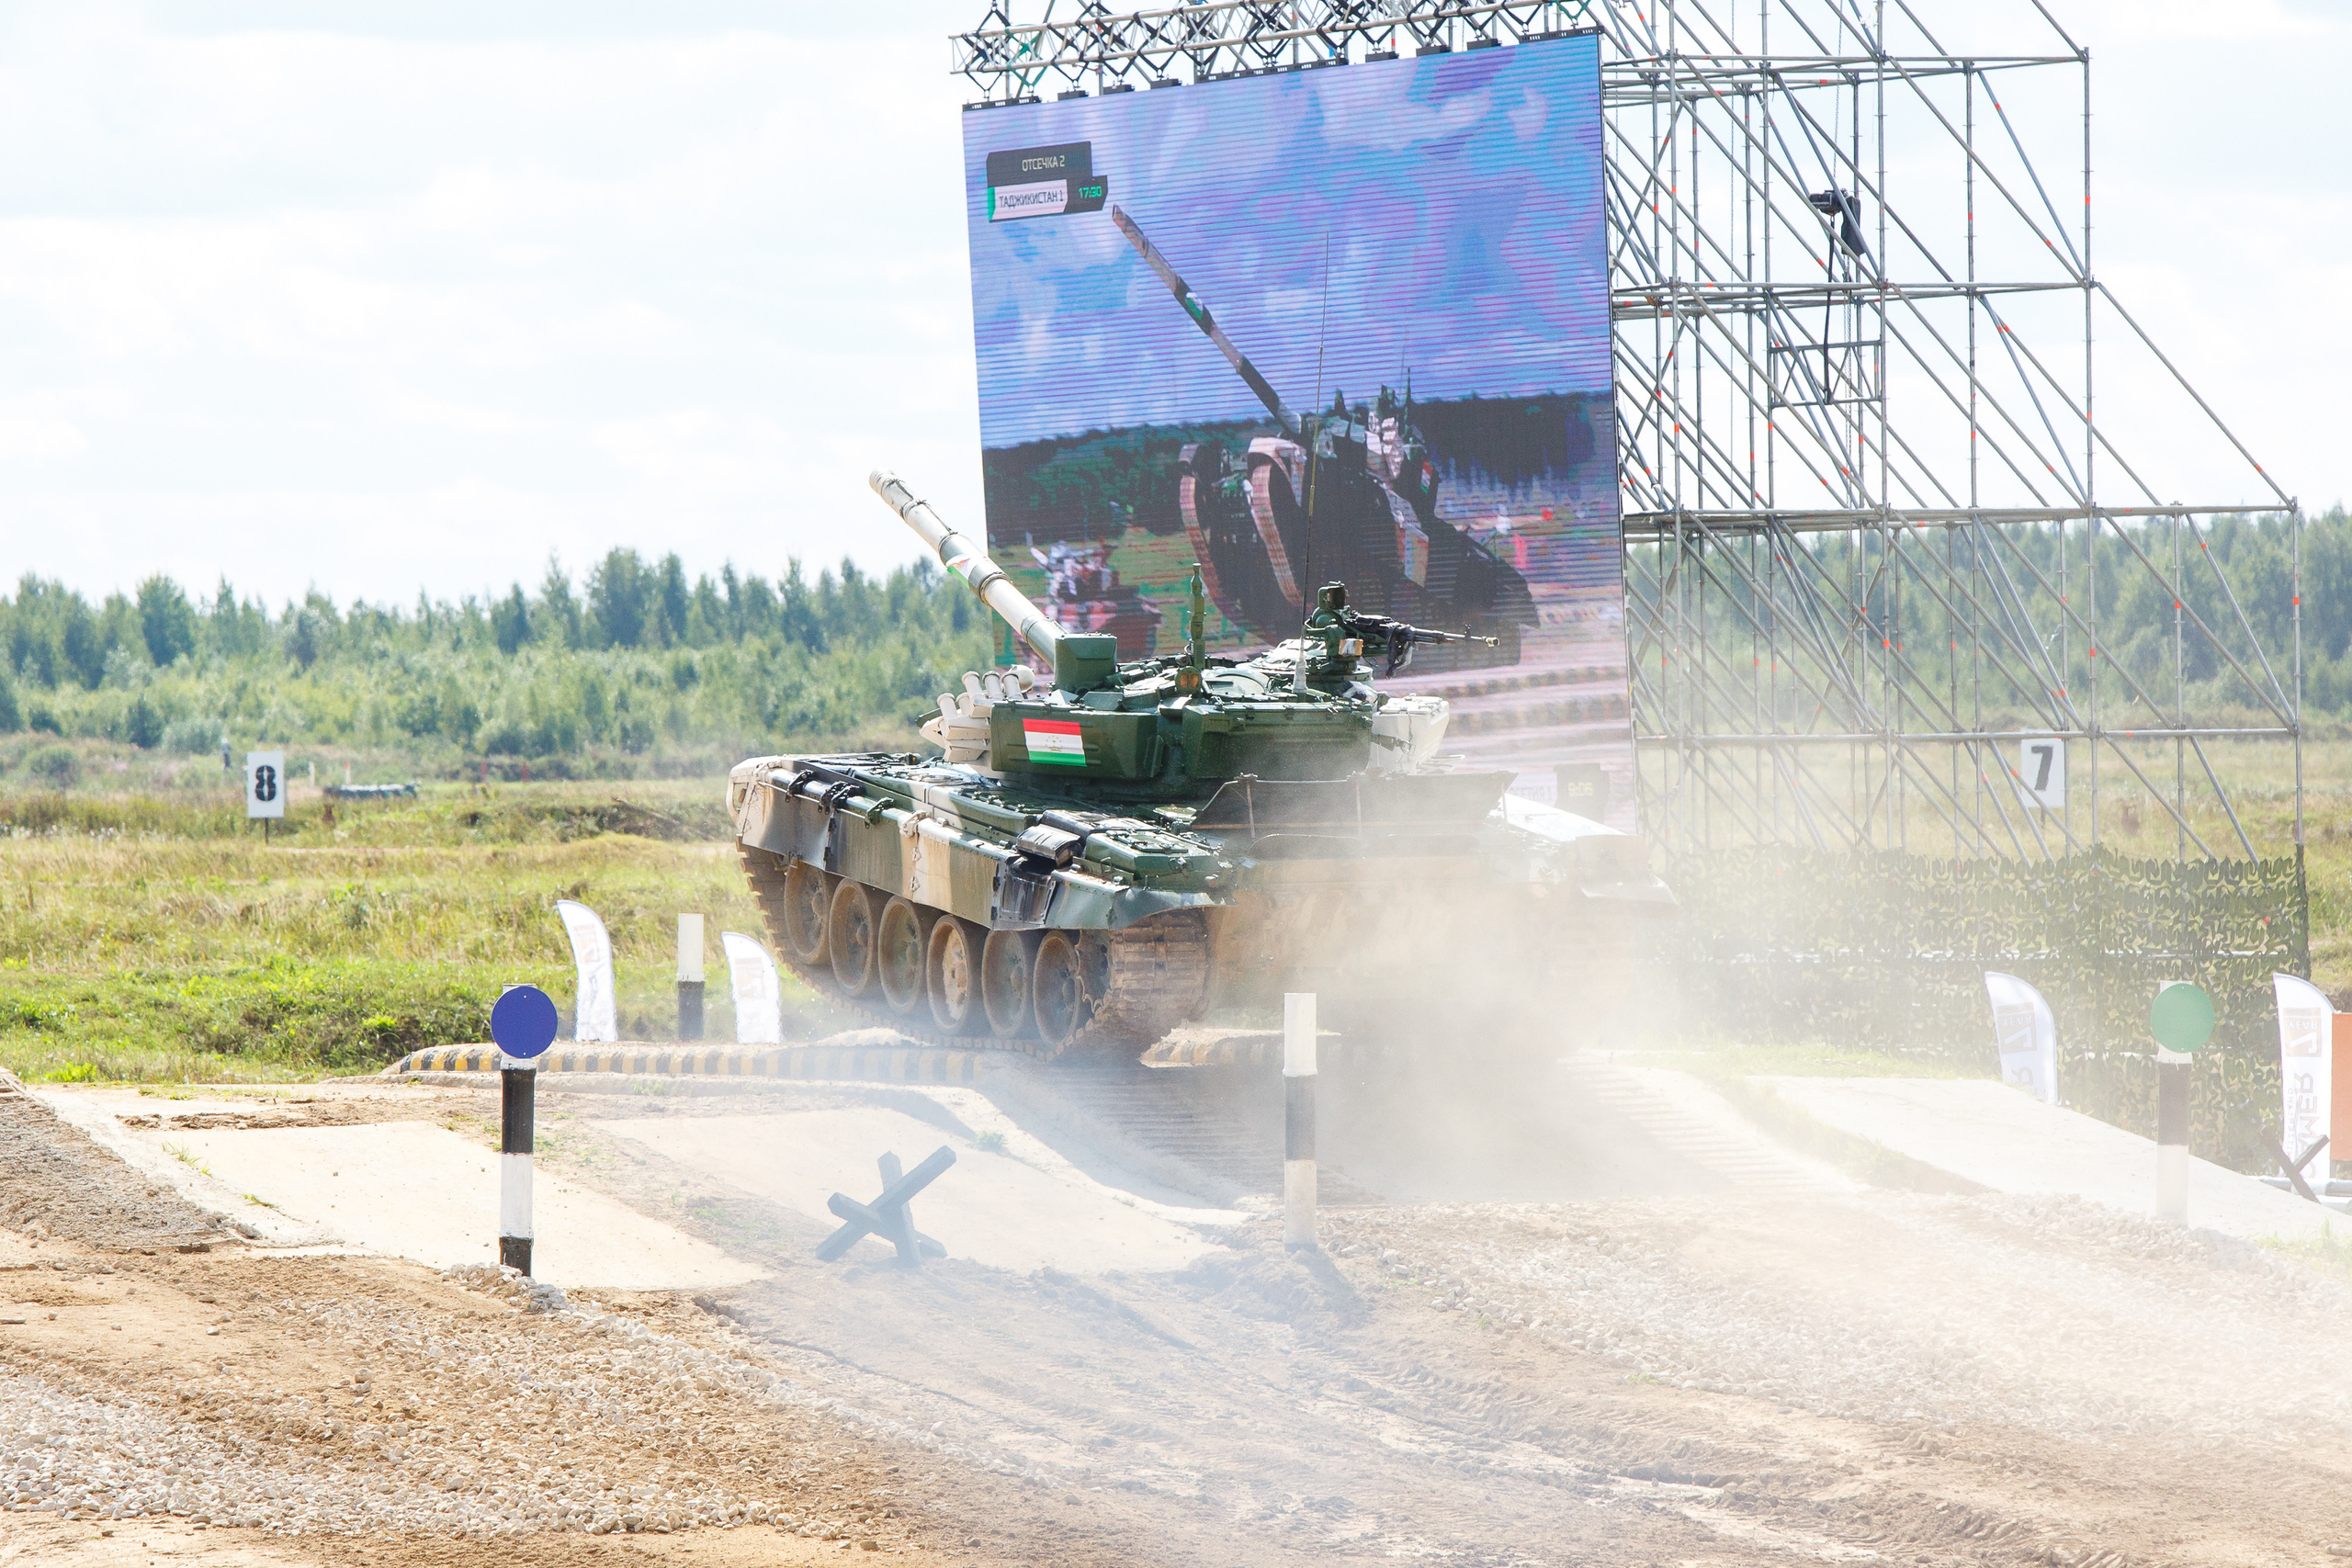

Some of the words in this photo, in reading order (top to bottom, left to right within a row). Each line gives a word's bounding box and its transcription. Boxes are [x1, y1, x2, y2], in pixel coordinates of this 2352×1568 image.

[1022, 156, 1058, 172] ОТСЕЧКА
[1059, 155, 1066, 167] 2
[999, 191, 1057, 209] ТАДЖИКИСТАН
[1059, 189, 1064, 202] 1
[1078, 186, 1102, 199] 17:30
[2030, 746, 2053, 791] 7
[255, 765, 277, 802] 8
